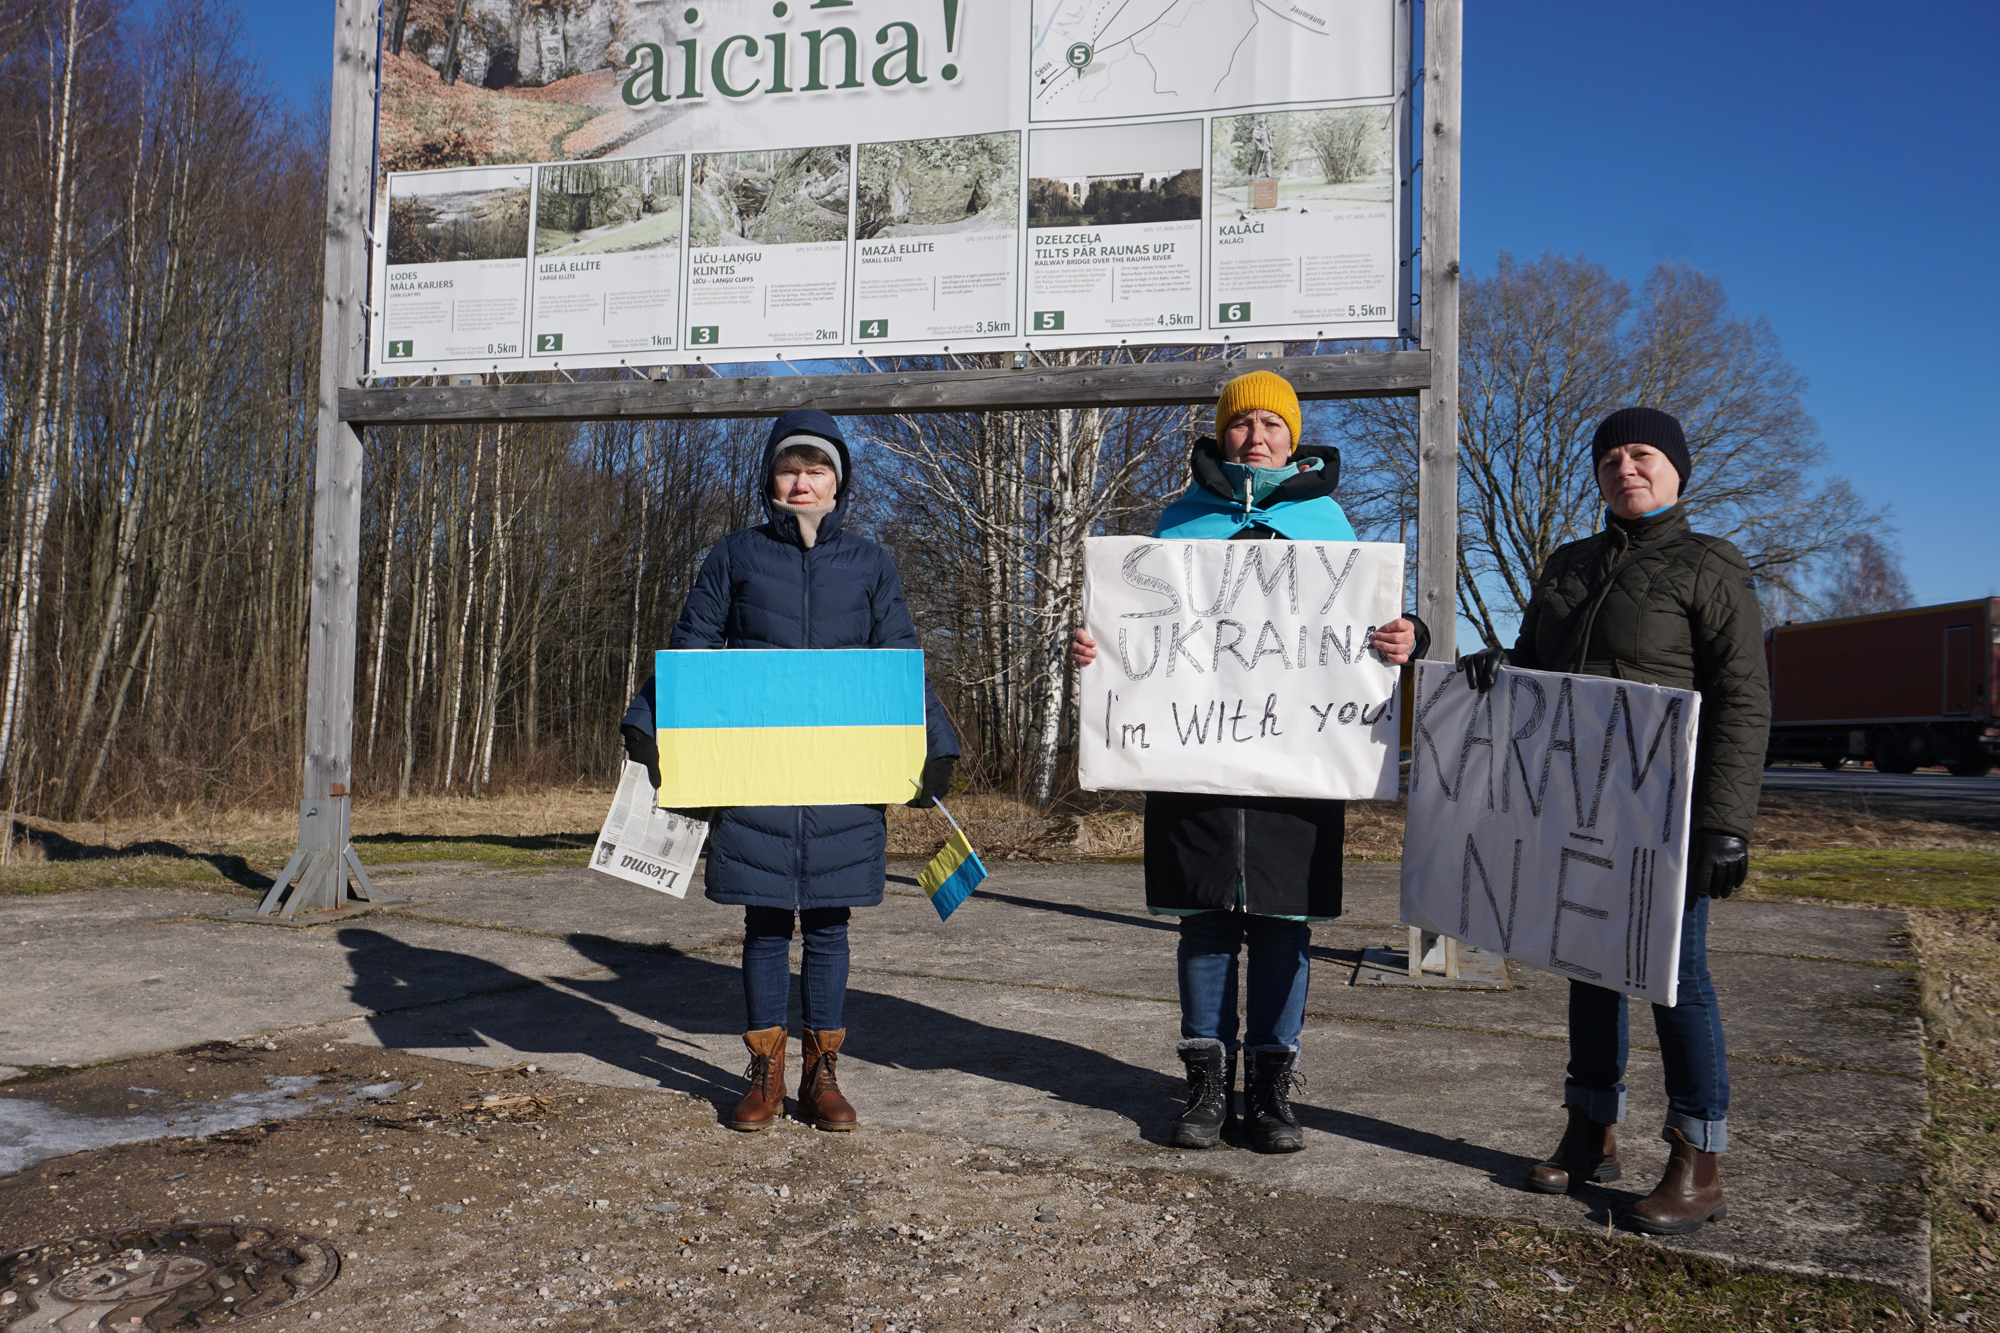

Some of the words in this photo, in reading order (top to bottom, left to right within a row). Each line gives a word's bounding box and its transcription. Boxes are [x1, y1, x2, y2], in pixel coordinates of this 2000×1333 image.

[1290, 5, 1326, 26] Jaunrauna
[622, 0, 958, 106] aicina!
[1073, 48, 1086, 63] 5
[1035, 62, 1052, 77] Cēsis
[1220, 221, 1264, 235] KALĀČI
[1036, 234, 1101, 245] DZELZCEĻA
[862, 244, 896, 256] MAZĀ
[900, 242, 934, 253] ELLĪTE
[1036, 248, 1069, 258] TILTS
[1074, 245, 1096, 257] PĀR
[1101, 244, 1149, 256] RAUNAS
[1154, 243, 1174, 253] UPI
[694, 252, 761, 264] LĪČU-LAŅĢU
[540, 262, 566, 273] LIELĀ
[570, 260, 600, 271] ELLĪTE
[694, 266, 735, 276] KLINTIS
[391, 272, 417, 280] LODES
[390, 281, 415, 291] MĀLA
[418, 280, 453, 289] KARJERS
[1228, 305, 1241, 320] 6
[1349, 305, 1386, 318] 5,5km
[976, 321, 1010, 334] 3,5km
[1043, 313, 1055, 328] 5
[1158, 314, 1193, 327] 4,5km
[699, 328, 710, 342] 3
[816, 330, 838, 340] 2km
[867, 322, 879, 336] 4
[545, 336, 555, 350] 2
[651, 336, 671, 345] 1km
[396, 342, 404, 356] 1
[488, 344, 516, 355] 0,5km
[1120, 544, 1360, 618] SUMY
[1106, 690, 1150, 749] I'm
[1413, 665, 1682, 844] KARAM
[620, 854, 680, 888] Liesma
